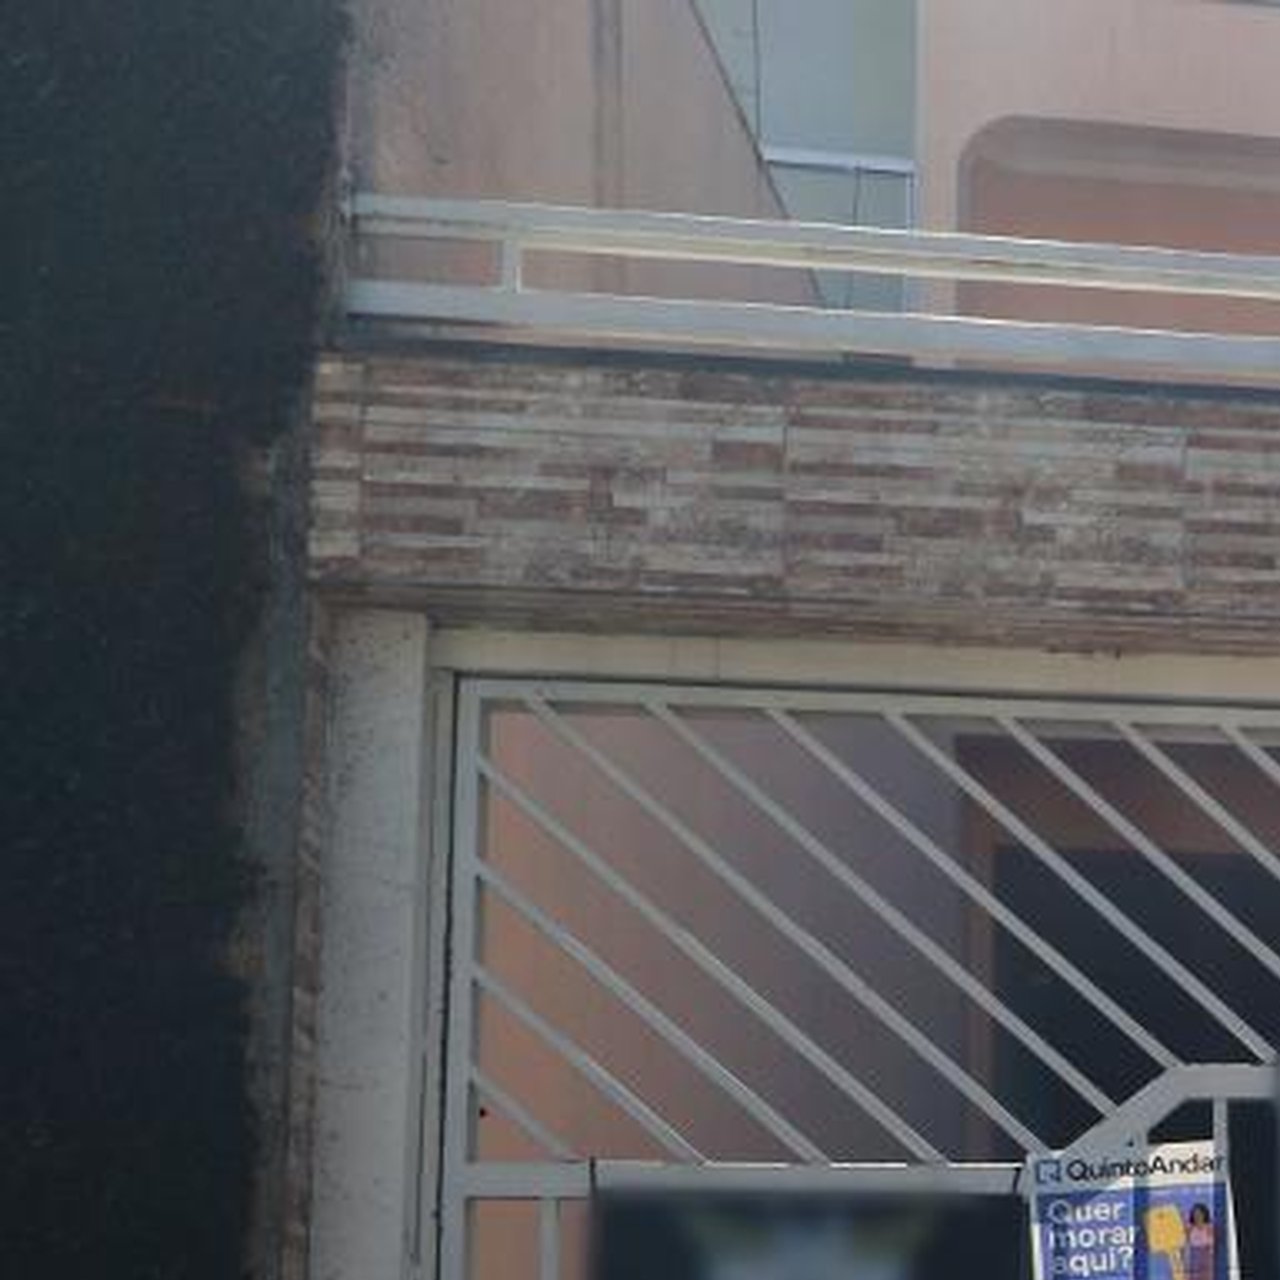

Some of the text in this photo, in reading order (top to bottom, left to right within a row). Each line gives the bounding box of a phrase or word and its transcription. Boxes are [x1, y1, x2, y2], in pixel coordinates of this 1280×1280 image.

[1066, 1152, 1225, 1183] QuintoAndar
[1049, 1200, 1126, 1224] Quer
[1049, 1224, 1140, 1248] morar
[1053, 1245, 1135, 1277] aqui?
